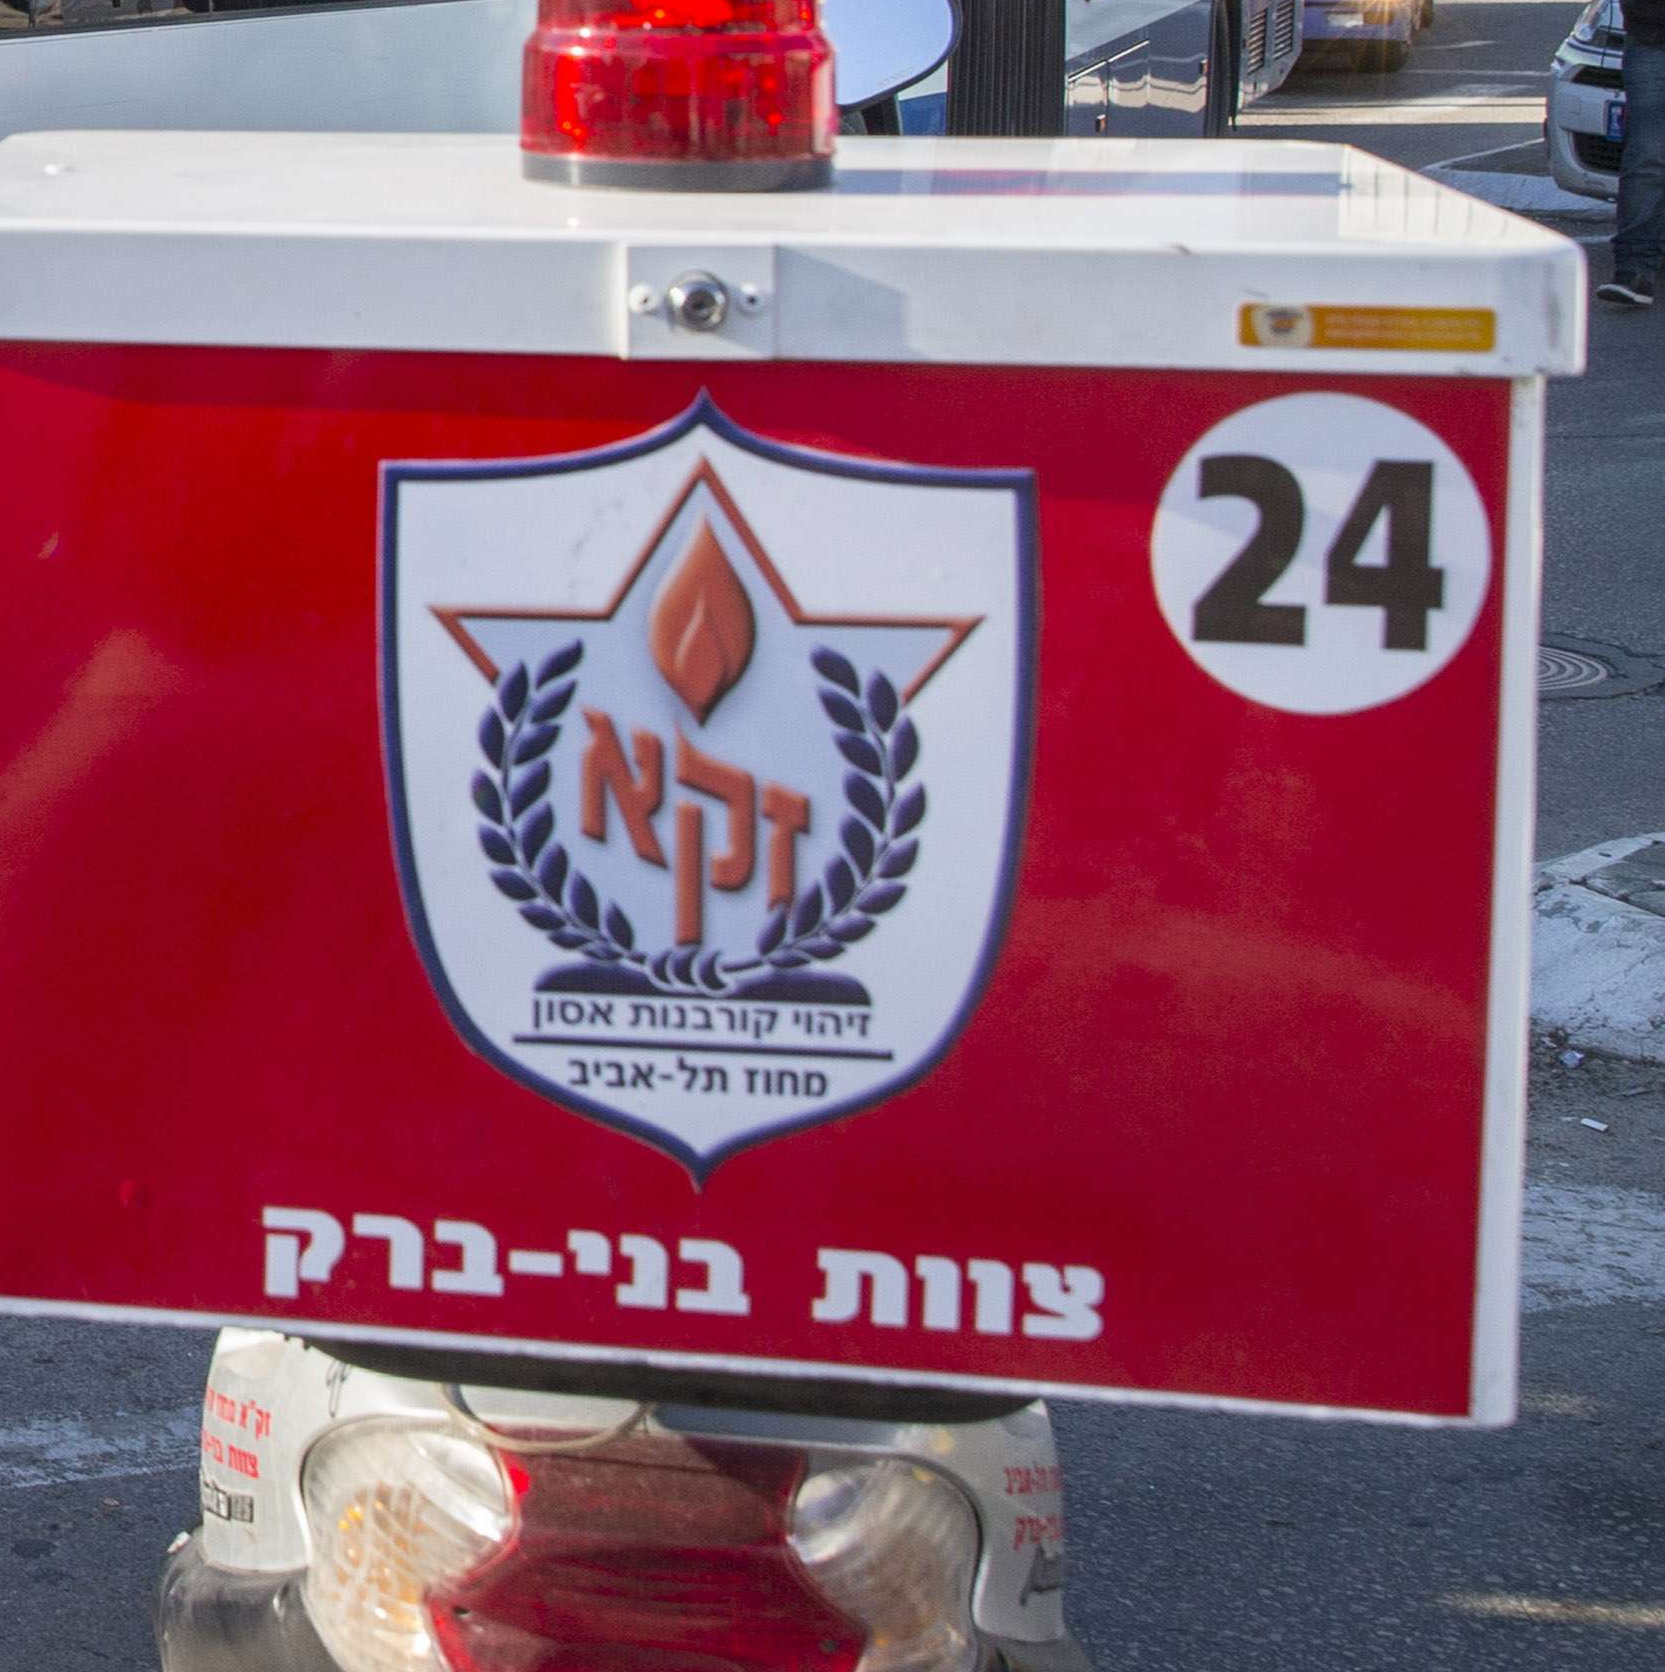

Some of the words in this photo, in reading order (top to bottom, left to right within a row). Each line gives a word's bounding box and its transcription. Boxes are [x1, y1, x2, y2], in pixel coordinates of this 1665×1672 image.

[1191, 454, 1444, 651] 24
[532, 996, 614, 1030] אסון
[629, 1000, 778, 1040] קורבנות
[791, 1008, 872, 1038] זיהוי
[569, 1055, 729, 1094] תל-אביב
[746, 1067, 827, 1098] מחוז
[262, 1205, 752, 1317] בני-ברק
[811, 1245, 1106, 1342] צוות
